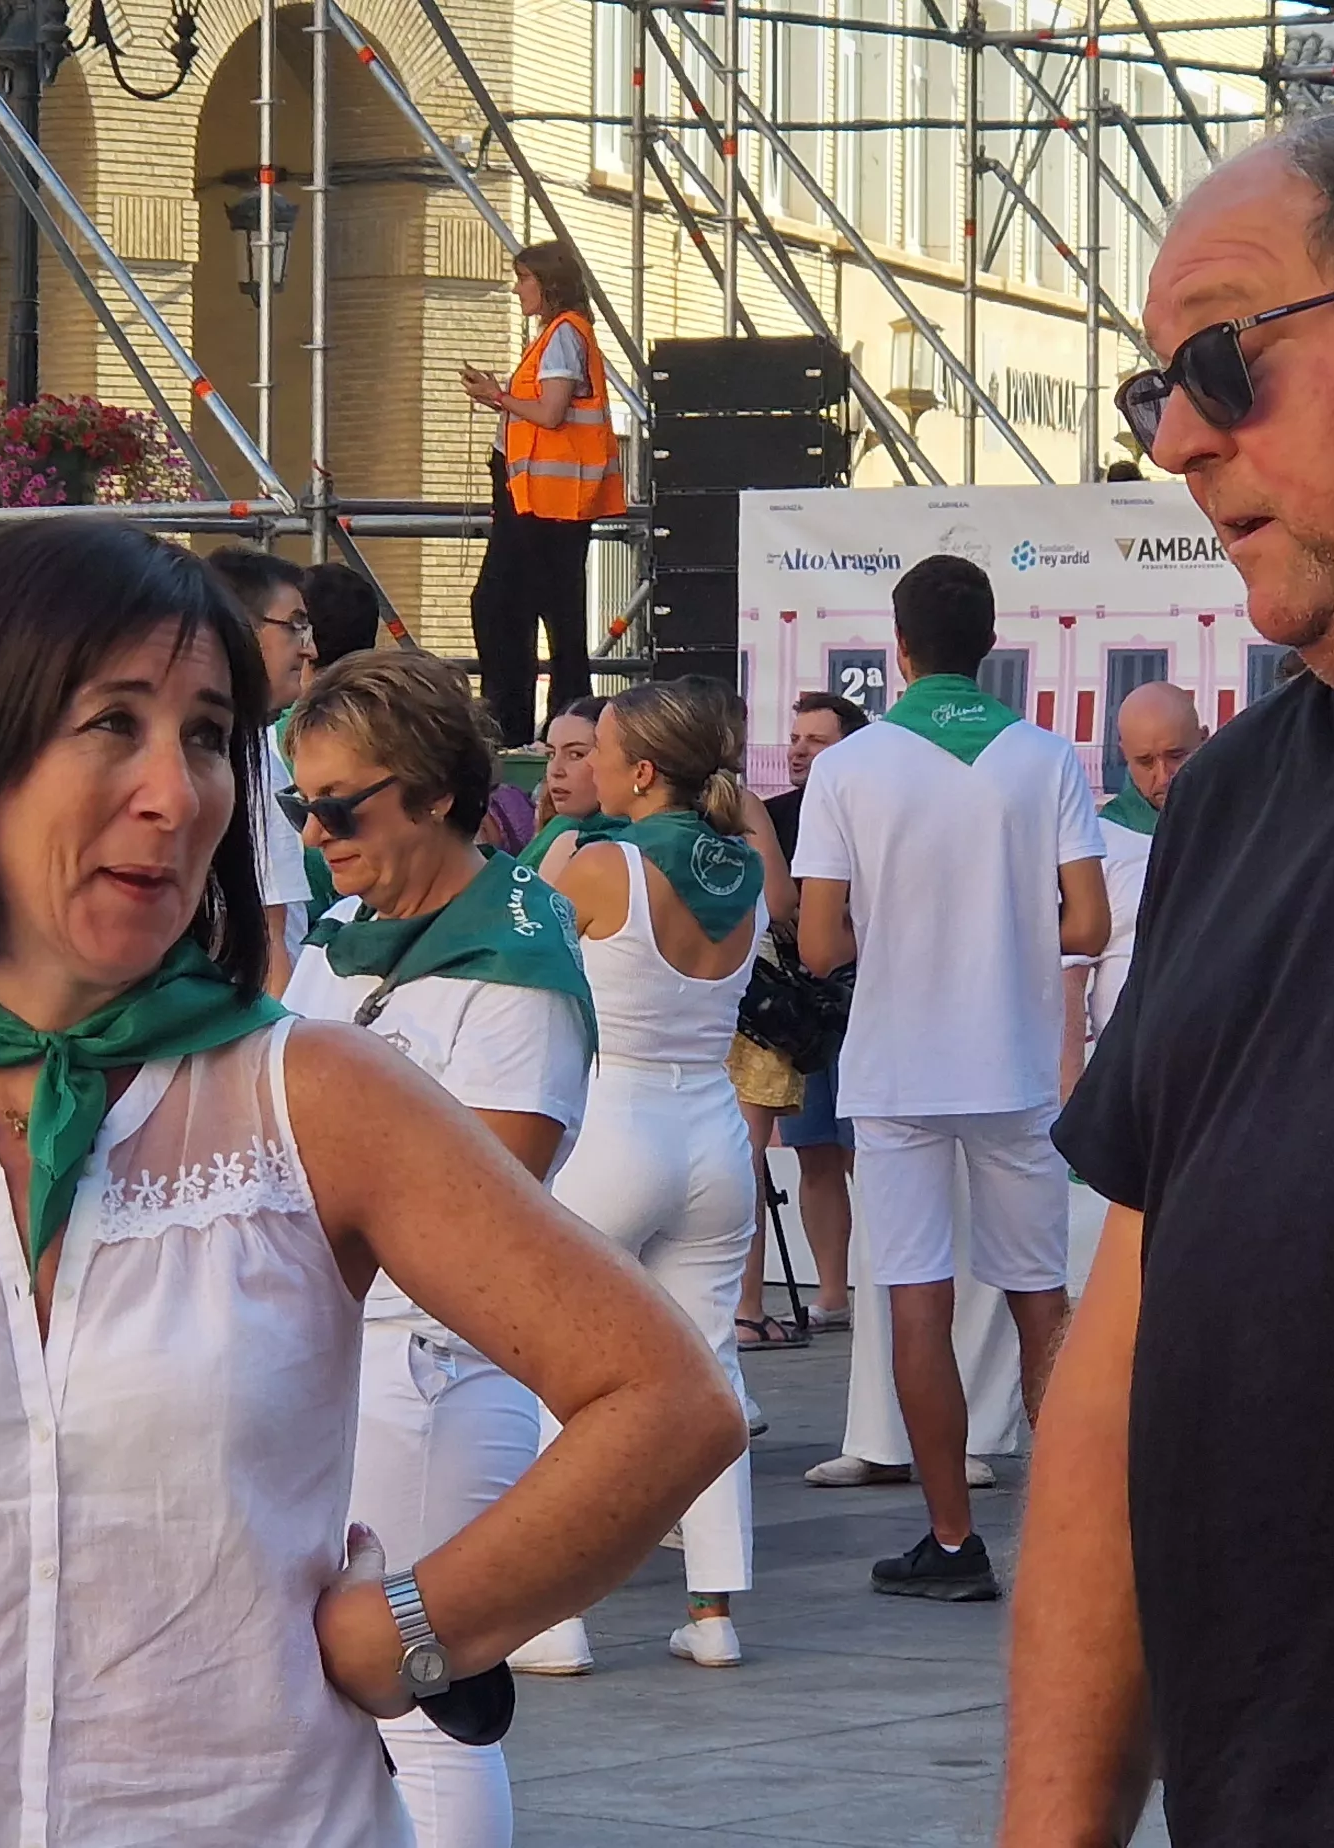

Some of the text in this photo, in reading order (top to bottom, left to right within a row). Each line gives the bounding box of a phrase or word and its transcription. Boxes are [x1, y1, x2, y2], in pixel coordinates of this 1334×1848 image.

[1039, 550, 1090, 568] rey ardid
[1137, 537, 1227, 562] AMBAR
